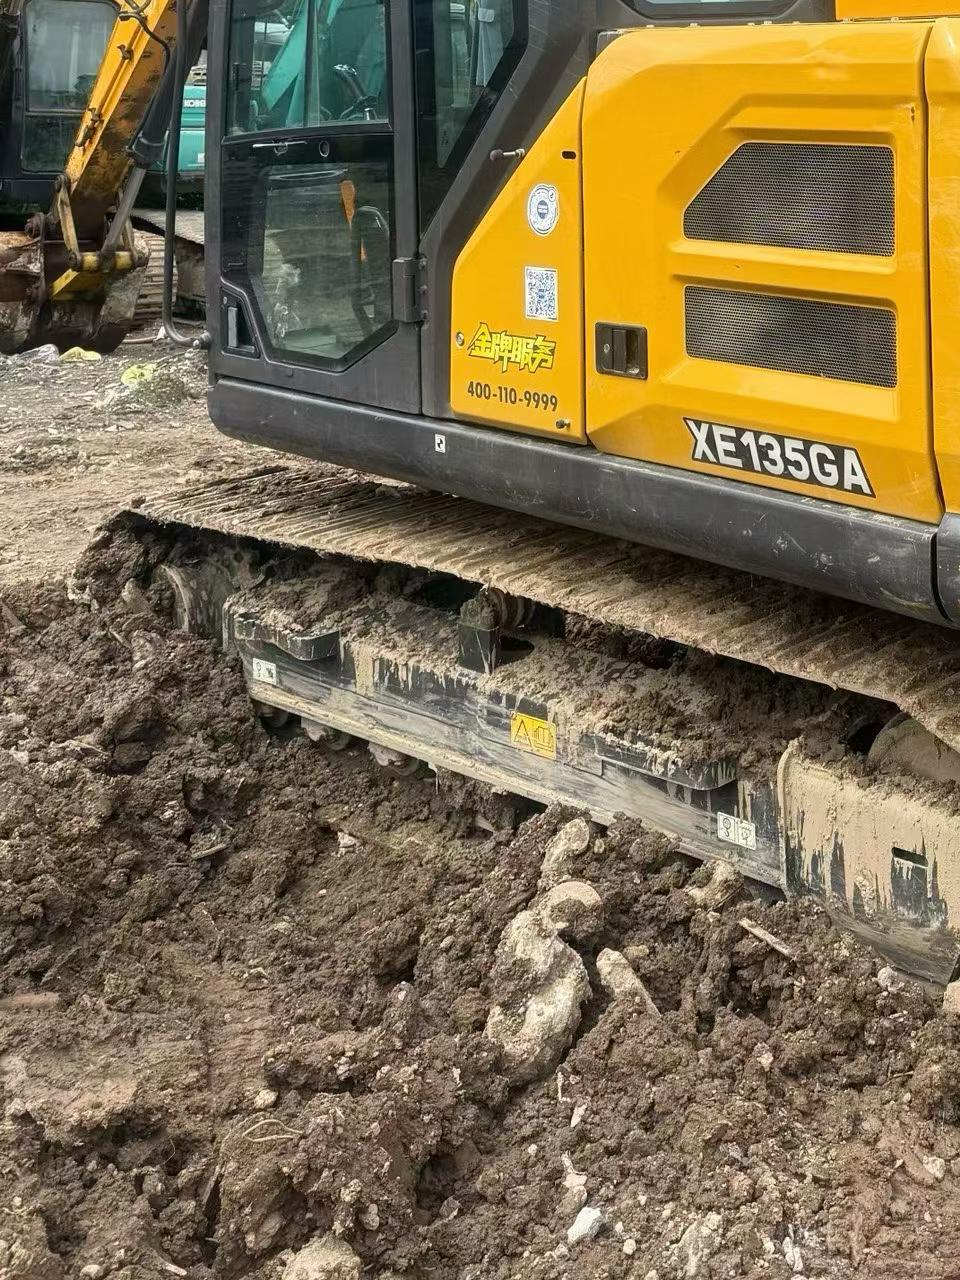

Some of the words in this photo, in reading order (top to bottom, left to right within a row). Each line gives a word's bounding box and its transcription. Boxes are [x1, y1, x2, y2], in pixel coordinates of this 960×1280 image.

[467, 322, 556, 373] 金牌服务
[467, 380, 558, 412] 400-110-9999
[685, 418, 873, 495] XE135GA
